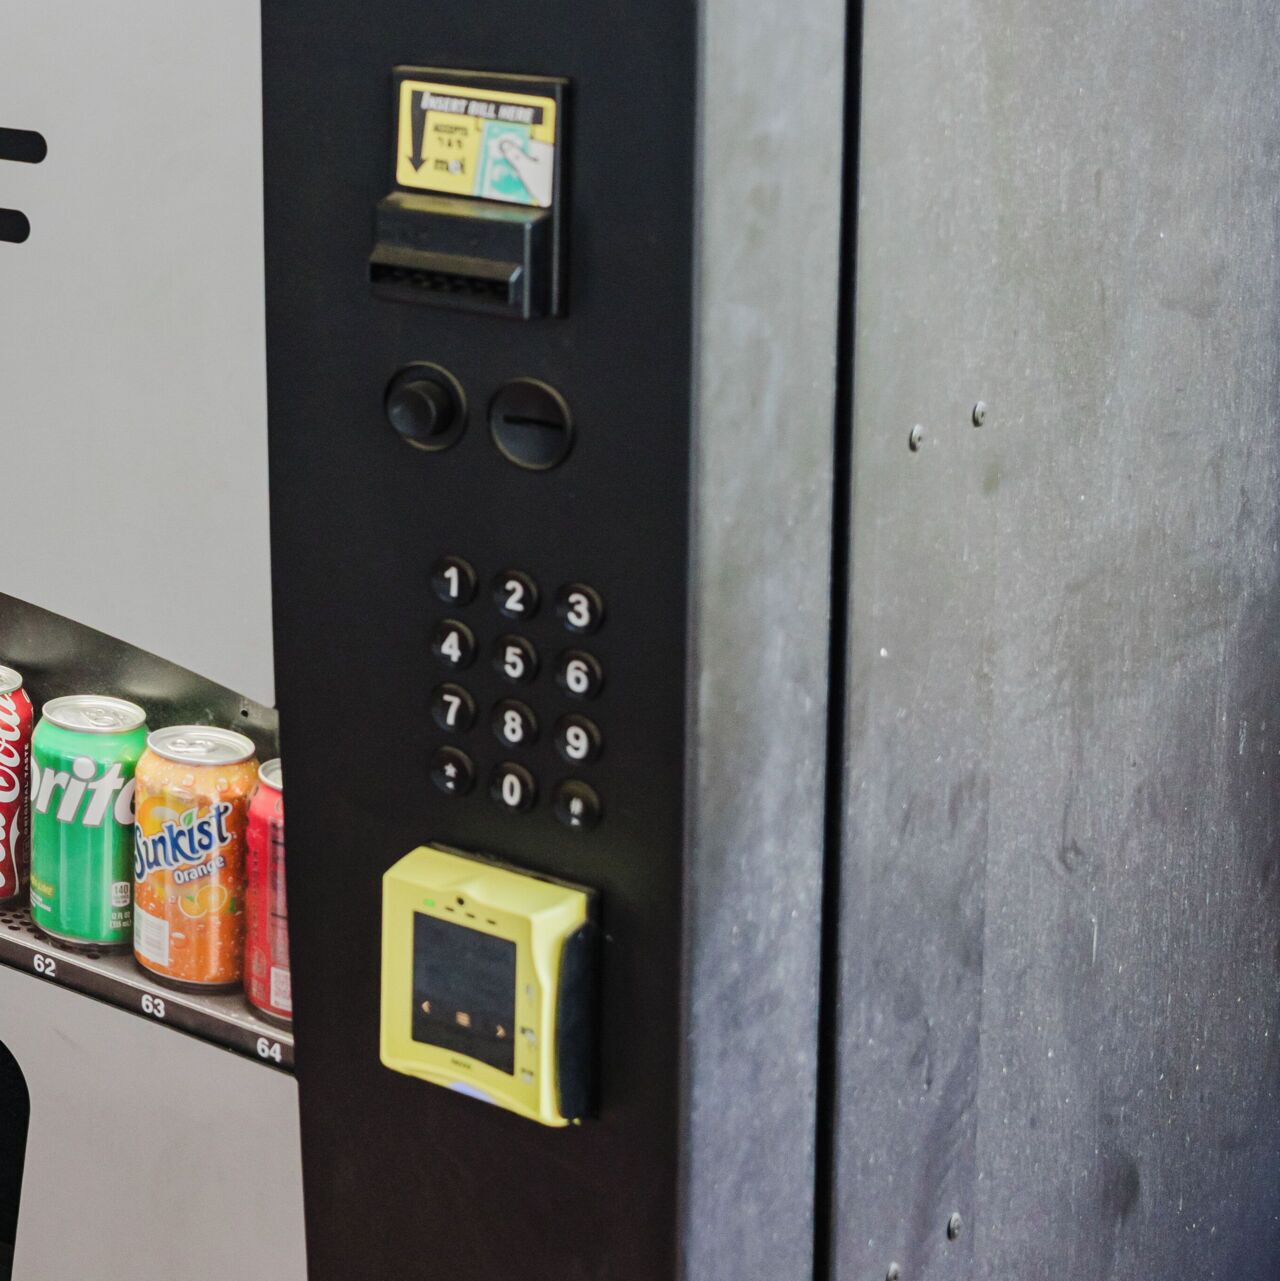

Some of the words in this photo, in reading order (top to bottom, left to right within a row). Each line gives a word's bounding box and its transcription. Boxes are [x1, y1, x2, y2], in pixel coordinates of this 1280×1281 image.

[420, 91, 468, 115] INSERT
[467, 99, 497, 119] BILL
[497, 104, 535, 124] HERE
[444, 566, 459, 598] 1
[505, 580, 524, 612] 2
[567, 593, 590, 627] 3
[441, 631, 461, 663] 4
[504, 646, 524, 678] 5
[566, 660, 588, 693] 6
[443, 694, 461, 726] 7
[504, 710, 523, 743] 8
[566, 726, 588, 759] 9
[23, 742, 31, 776] TASTE
[502, 773, 521, 806] 0
[134, 803, 233, 880] Sunkist
[173, 854, 225, 885] Orange
[33, 953, 56, 978] 62
[140, 993, 165, 1019] 63
[255, 1036, 282, 1064] 64
